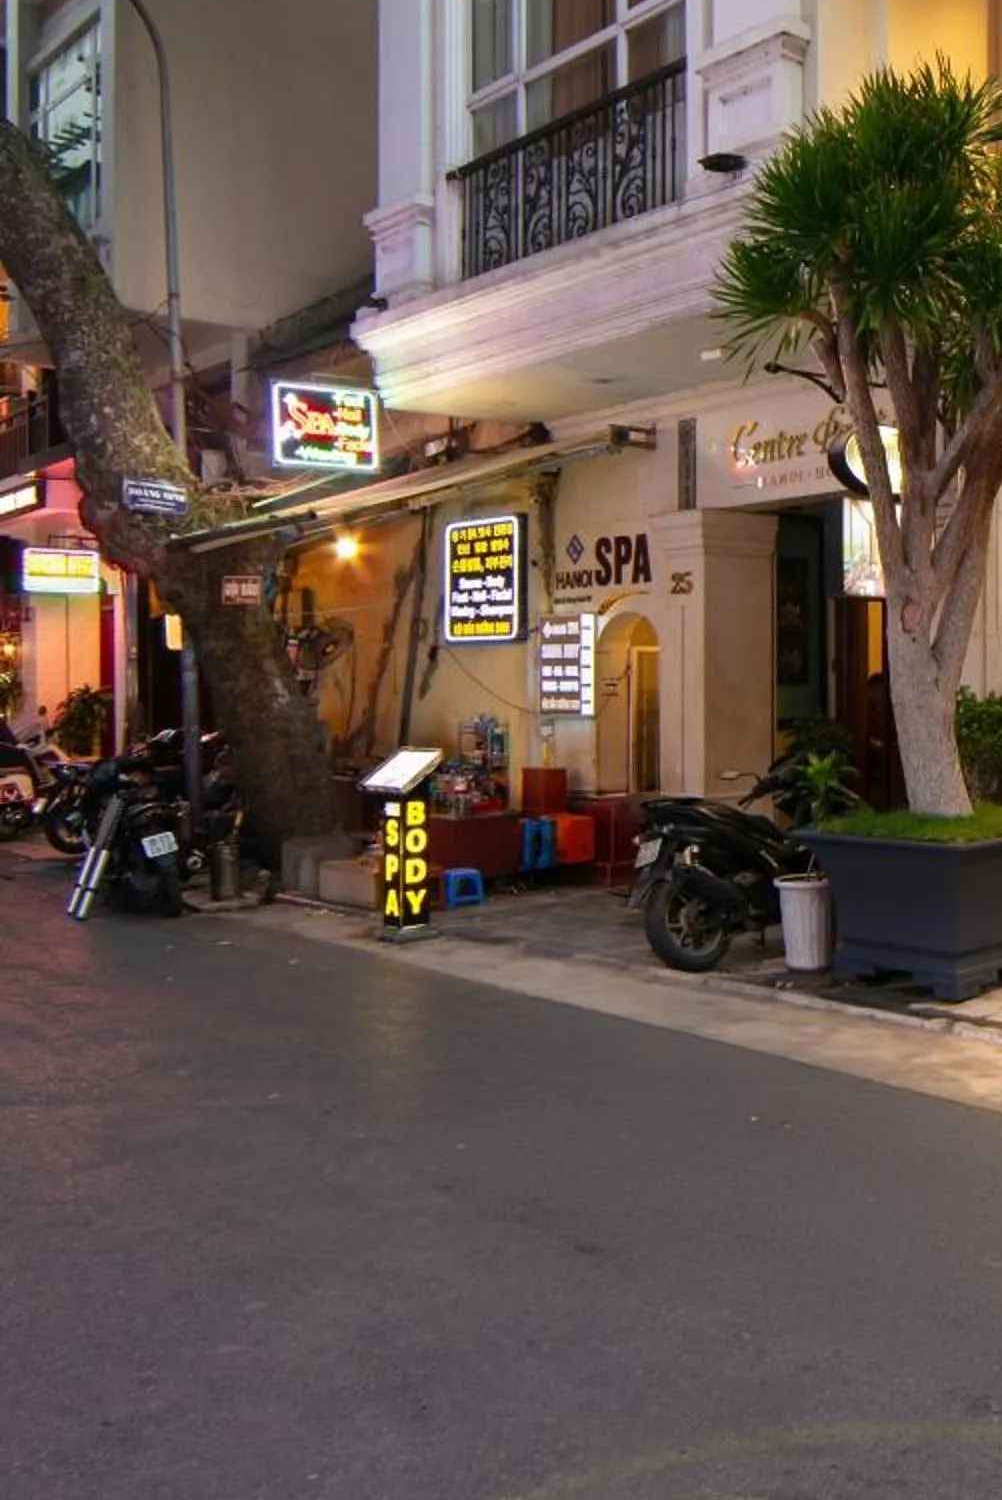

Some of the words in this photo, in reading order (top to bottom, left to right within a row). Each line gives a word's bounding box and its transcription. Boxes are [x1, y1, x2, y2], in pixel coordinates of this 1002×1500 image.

[731, 419, 809, 468] Centre
[555, 569, 593, 590] HANOI
[595, 533, 652, 587] SPA
[670, 571, 694, 595] 25
[385, 818, 400, 918] SPA
[405, 800, 428, 915] BODY
